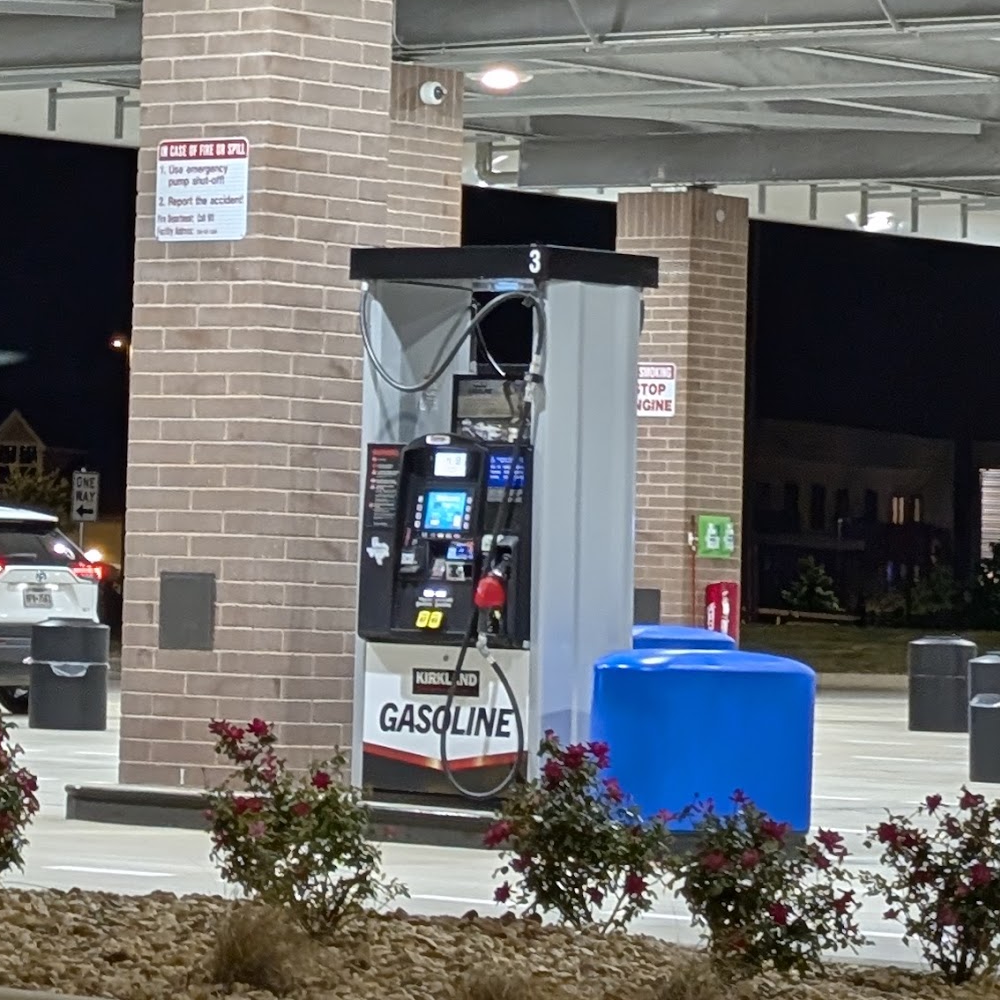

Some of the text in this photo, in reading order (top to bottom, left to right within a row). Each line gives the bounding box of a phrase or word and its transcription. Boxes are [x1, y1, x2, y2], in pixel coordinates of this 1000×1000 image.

[170, 145, 187, 158] CASE
[189, 144, 198, 157] OF
[200, 144, 214, 157] FIRE
[227, 142, 245, 156] SPILL
[168, 165, 183, 175] Use
[186, 165, 228, 175] emergency
[168, 178, 189, 188] pump
[168, 195, 193, 207] Report
[195, 195, 207, 205] the
[528, 249, 541, 273] 3
[637, 399, 672, 411] NGINE
[76, 476, 96, 489] ONE
[76, 490, 96, 502] WAY
[379, 702, 515, 738] GASOLINE
